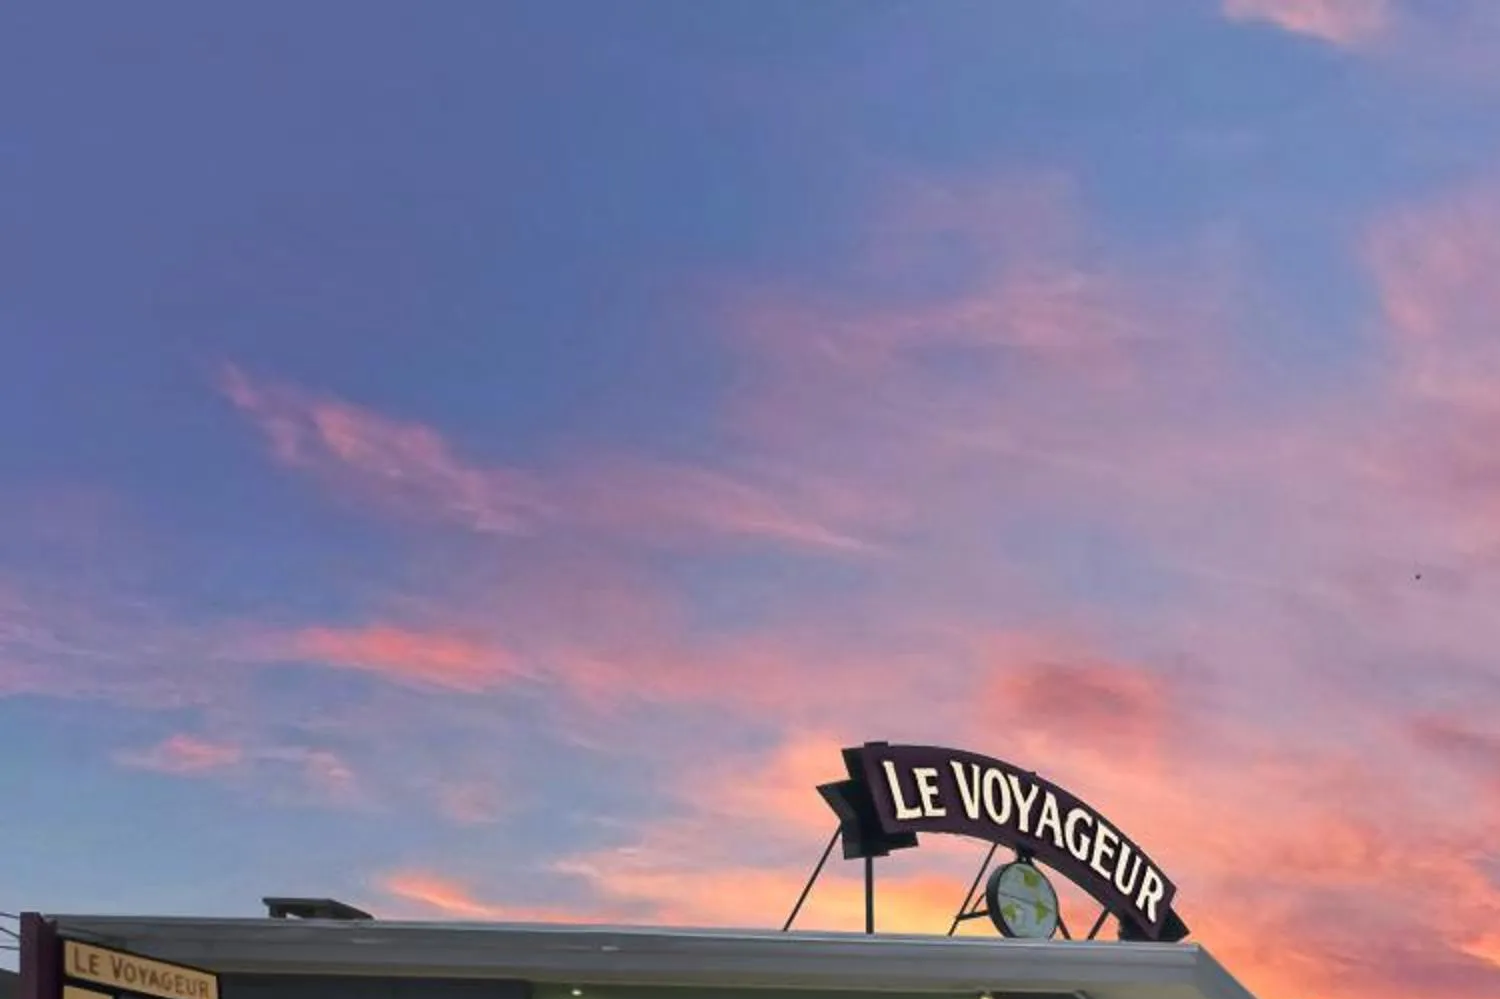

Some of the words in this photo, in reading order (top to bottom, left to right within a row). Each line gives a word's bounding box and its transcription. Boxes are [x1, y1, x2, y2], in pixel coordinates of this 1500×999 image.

[882, 760, 947, 820] LE
[950, 760, 1165, 924] VOYAGEUR
[74, 946, 99, 975] LE
[109, 956, 210, 999] VOYAGEUR
